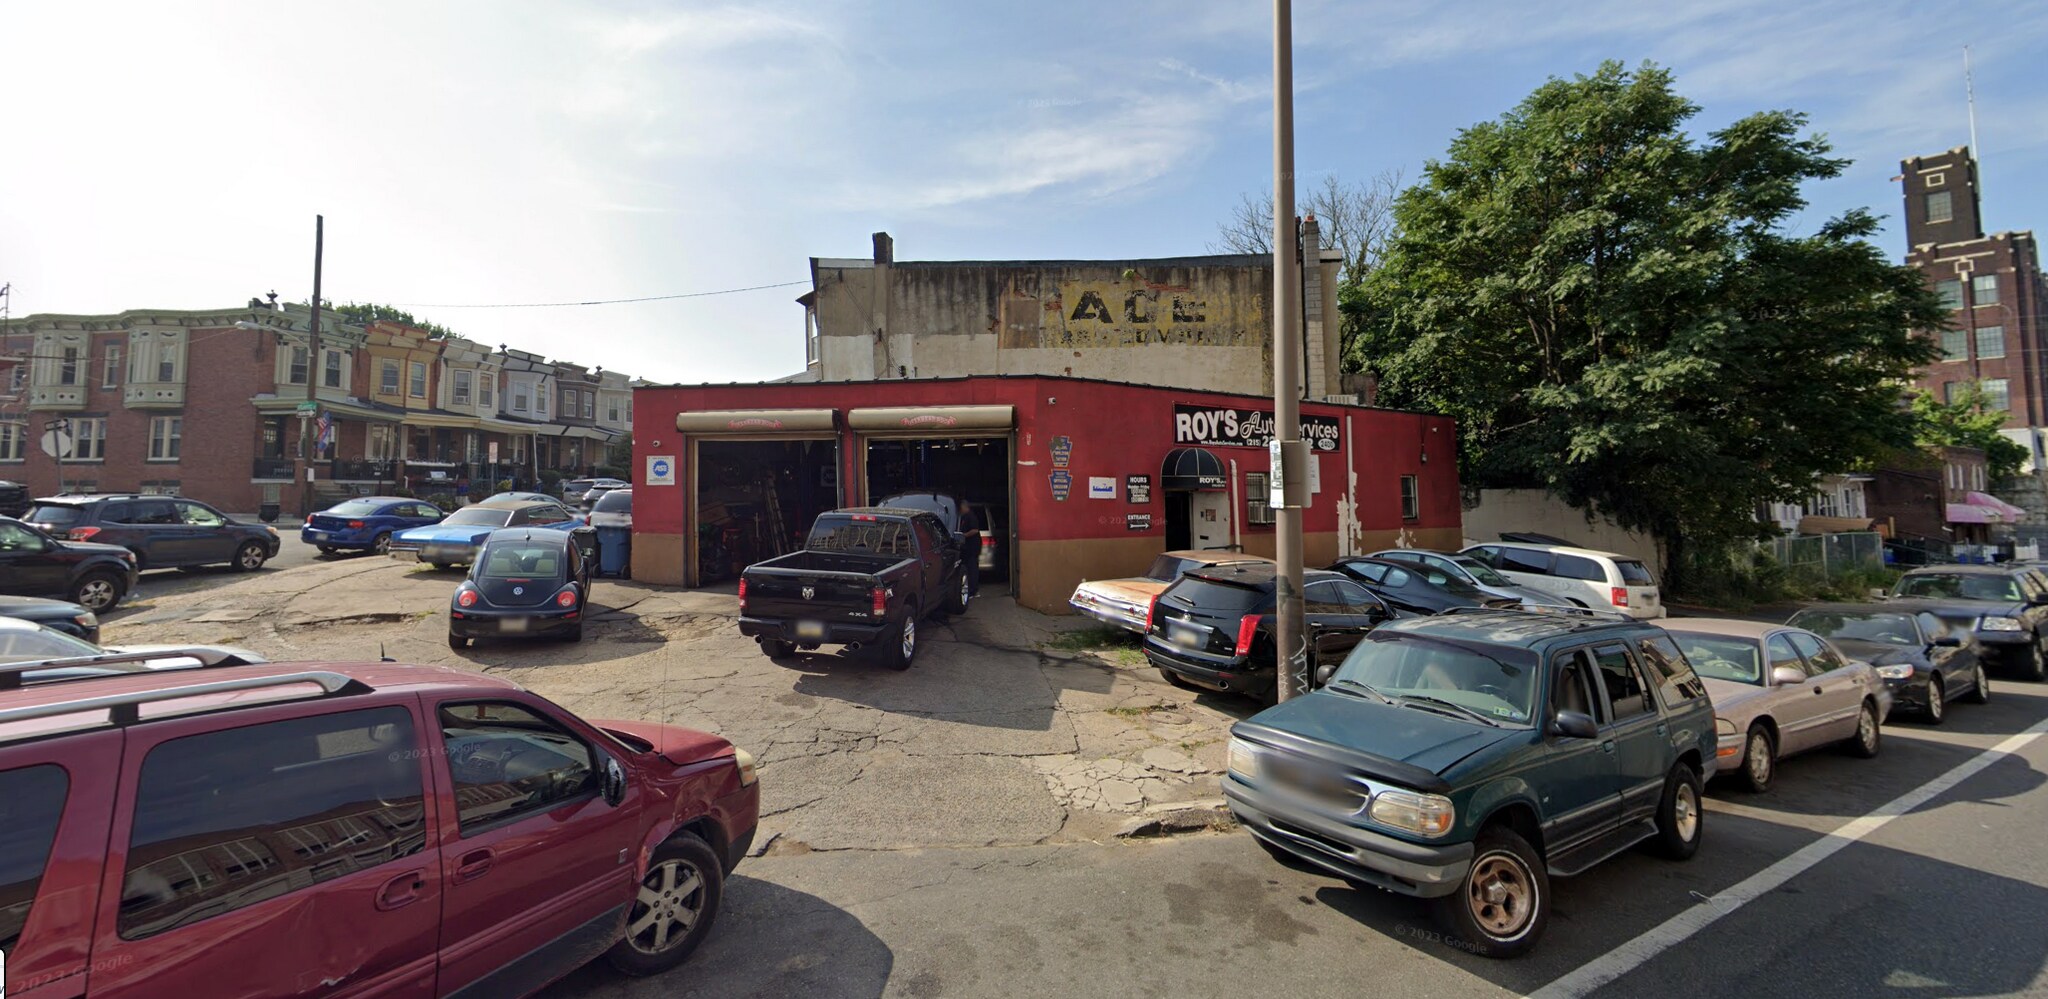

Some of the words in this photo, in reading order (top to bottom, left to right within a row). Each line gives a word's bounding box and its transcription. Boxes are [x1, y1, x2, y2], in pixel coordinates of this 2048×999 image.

[1070, 289, 1206, 324] ACE
[1176, 410, 1239, 442] ROY'S
[1240, 411, 1276, 439] Aut
[1246, 438, 1262, 447] (215)
